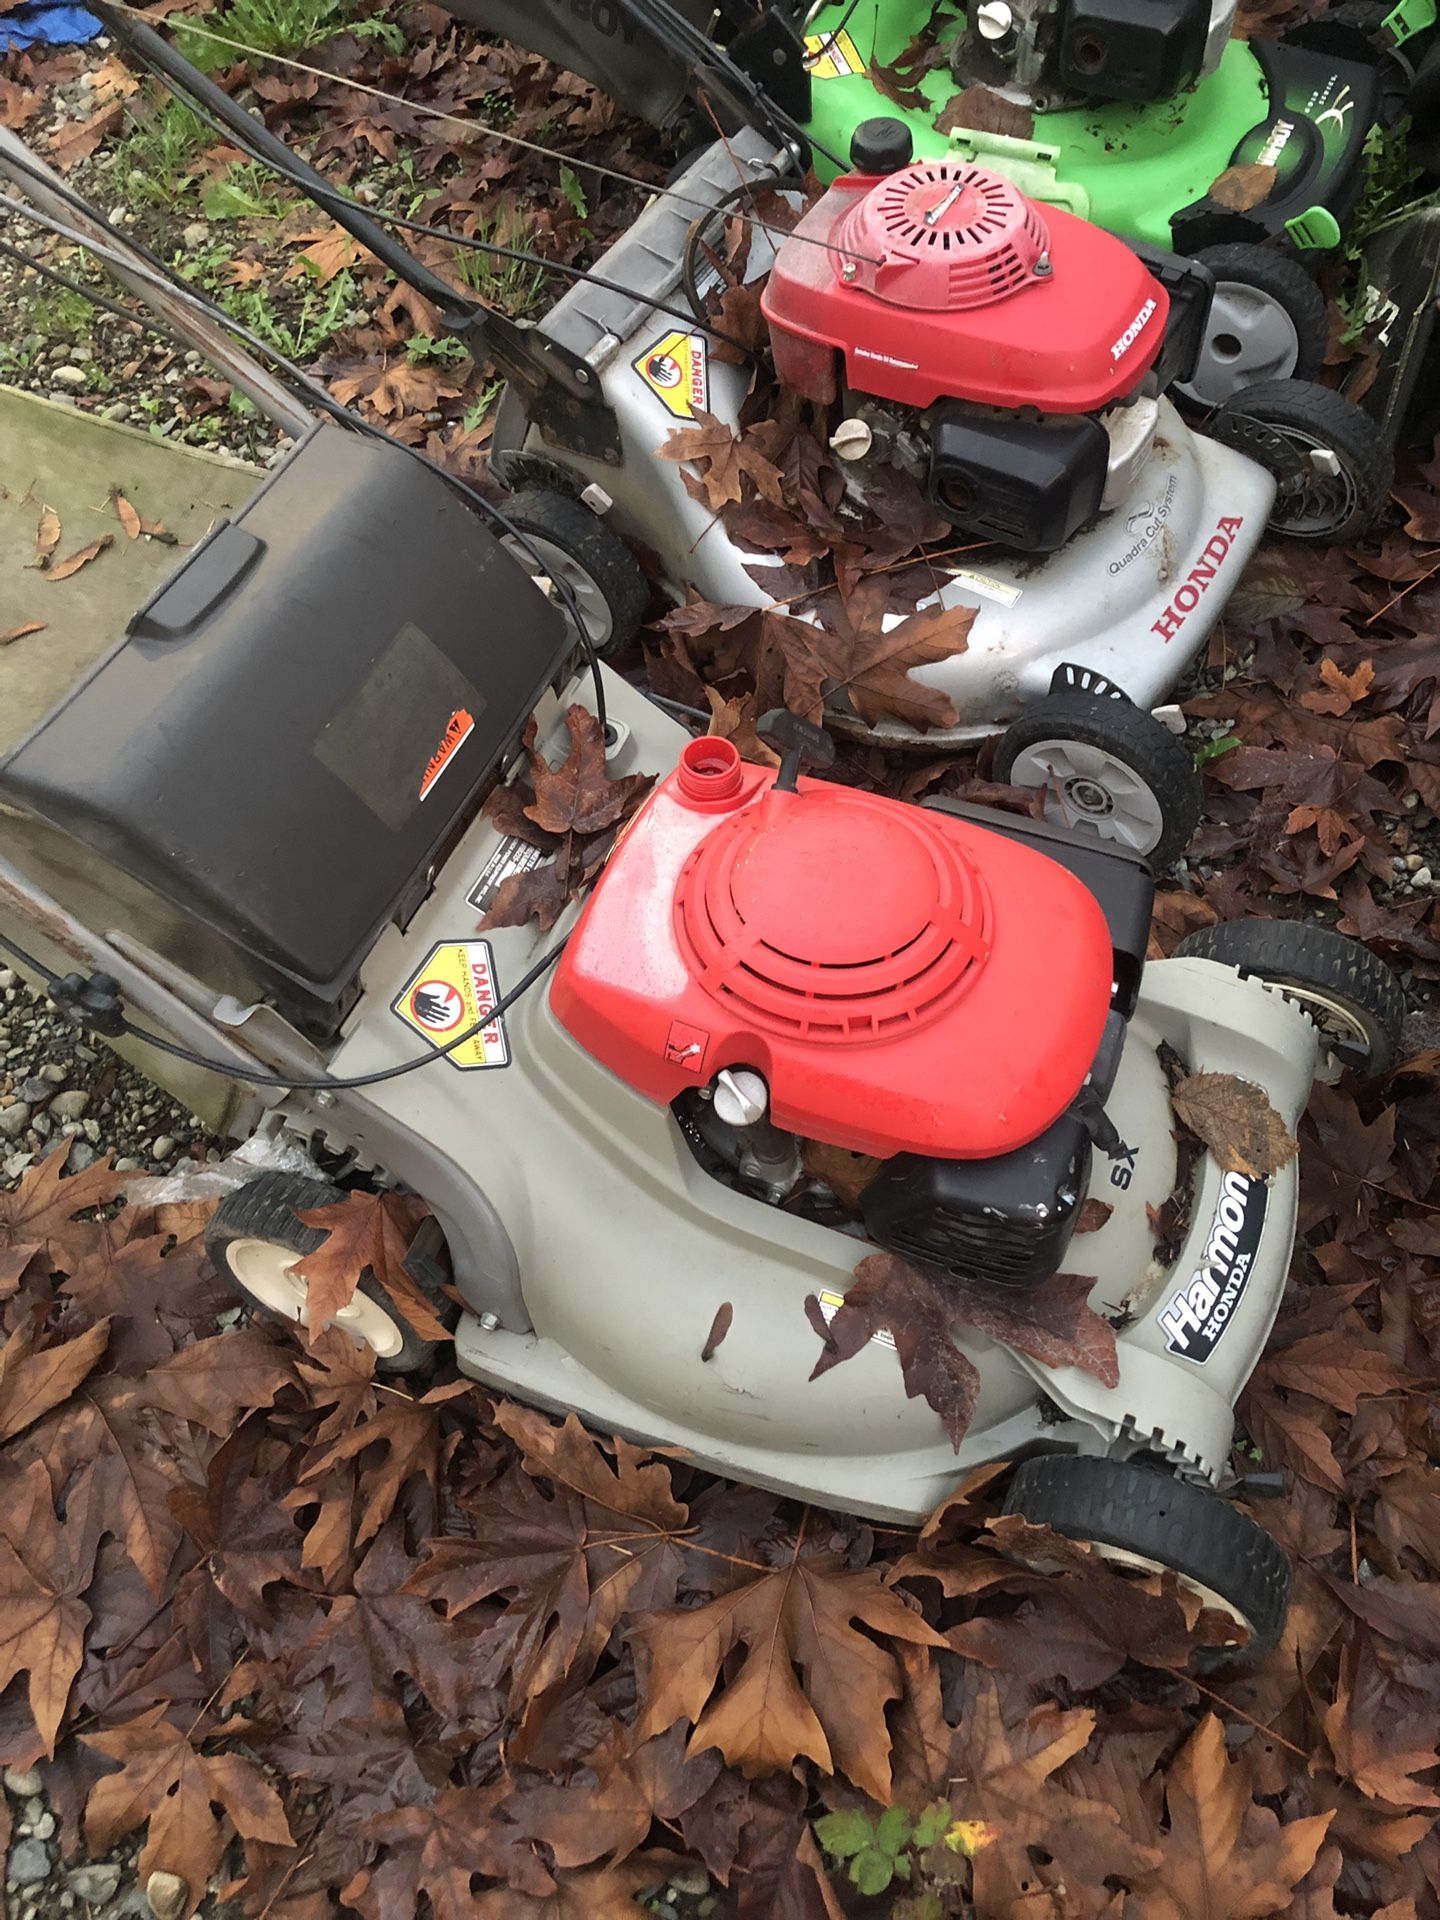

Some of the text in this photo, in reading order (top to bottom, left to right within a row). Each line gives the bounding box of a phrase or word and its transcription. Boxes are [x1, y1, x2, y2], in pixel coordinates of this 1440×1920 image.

[1109, 298, 1157, 361] HONDA
[691, 350, 704, 405] DANGER
[1108, 475, 1177, 576] Quadra Cut System
[1150, 516, 1244, 643] HONDA
[457, 948, 468, 971] KEEP
[462, 971, 473, 998] HANDS
[466, 1000, 475, 1015] and
[473, 1039, 484, 1060] AWAY
[1110, 1147, 1140, 1191] SX
[1161, 1170, 1256, 1350] Harmon
[1201, 1252, 1252, 1342] HONDA
